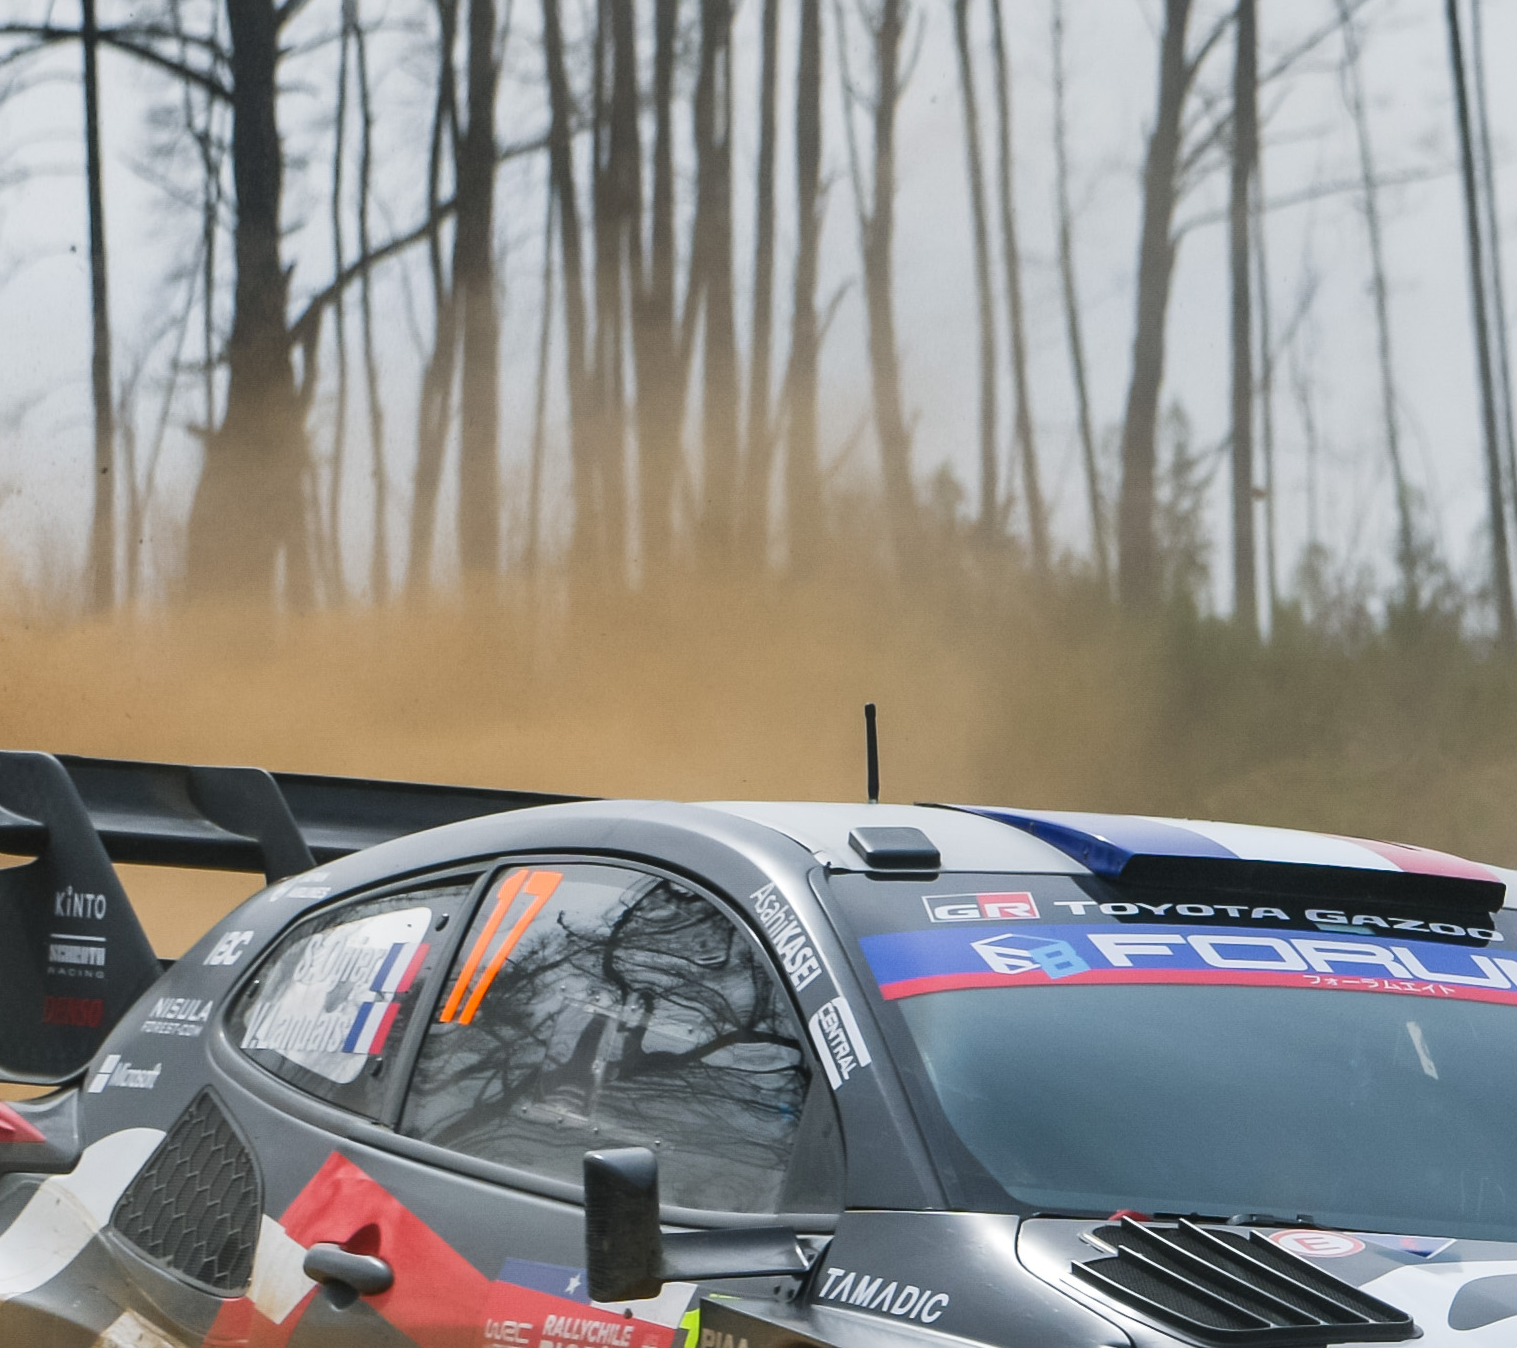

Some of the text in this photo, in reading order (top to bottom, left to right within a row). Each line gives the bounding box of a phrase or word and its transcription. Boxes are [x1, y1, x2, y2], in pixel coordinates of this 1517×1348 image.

[440, 869, 563, 1025] 17
[933, 902, 1033, 920] GR
[1053, 901, 1291, 921] TOYOTA
[1304, 909, 1504, 942] GAZOO
[1302, 974, 1455, 995] フォーラムエイト
[815, 1000, 858, 1081] CENTRAL
[818, 1267, 950, 1324] TAMADIC
